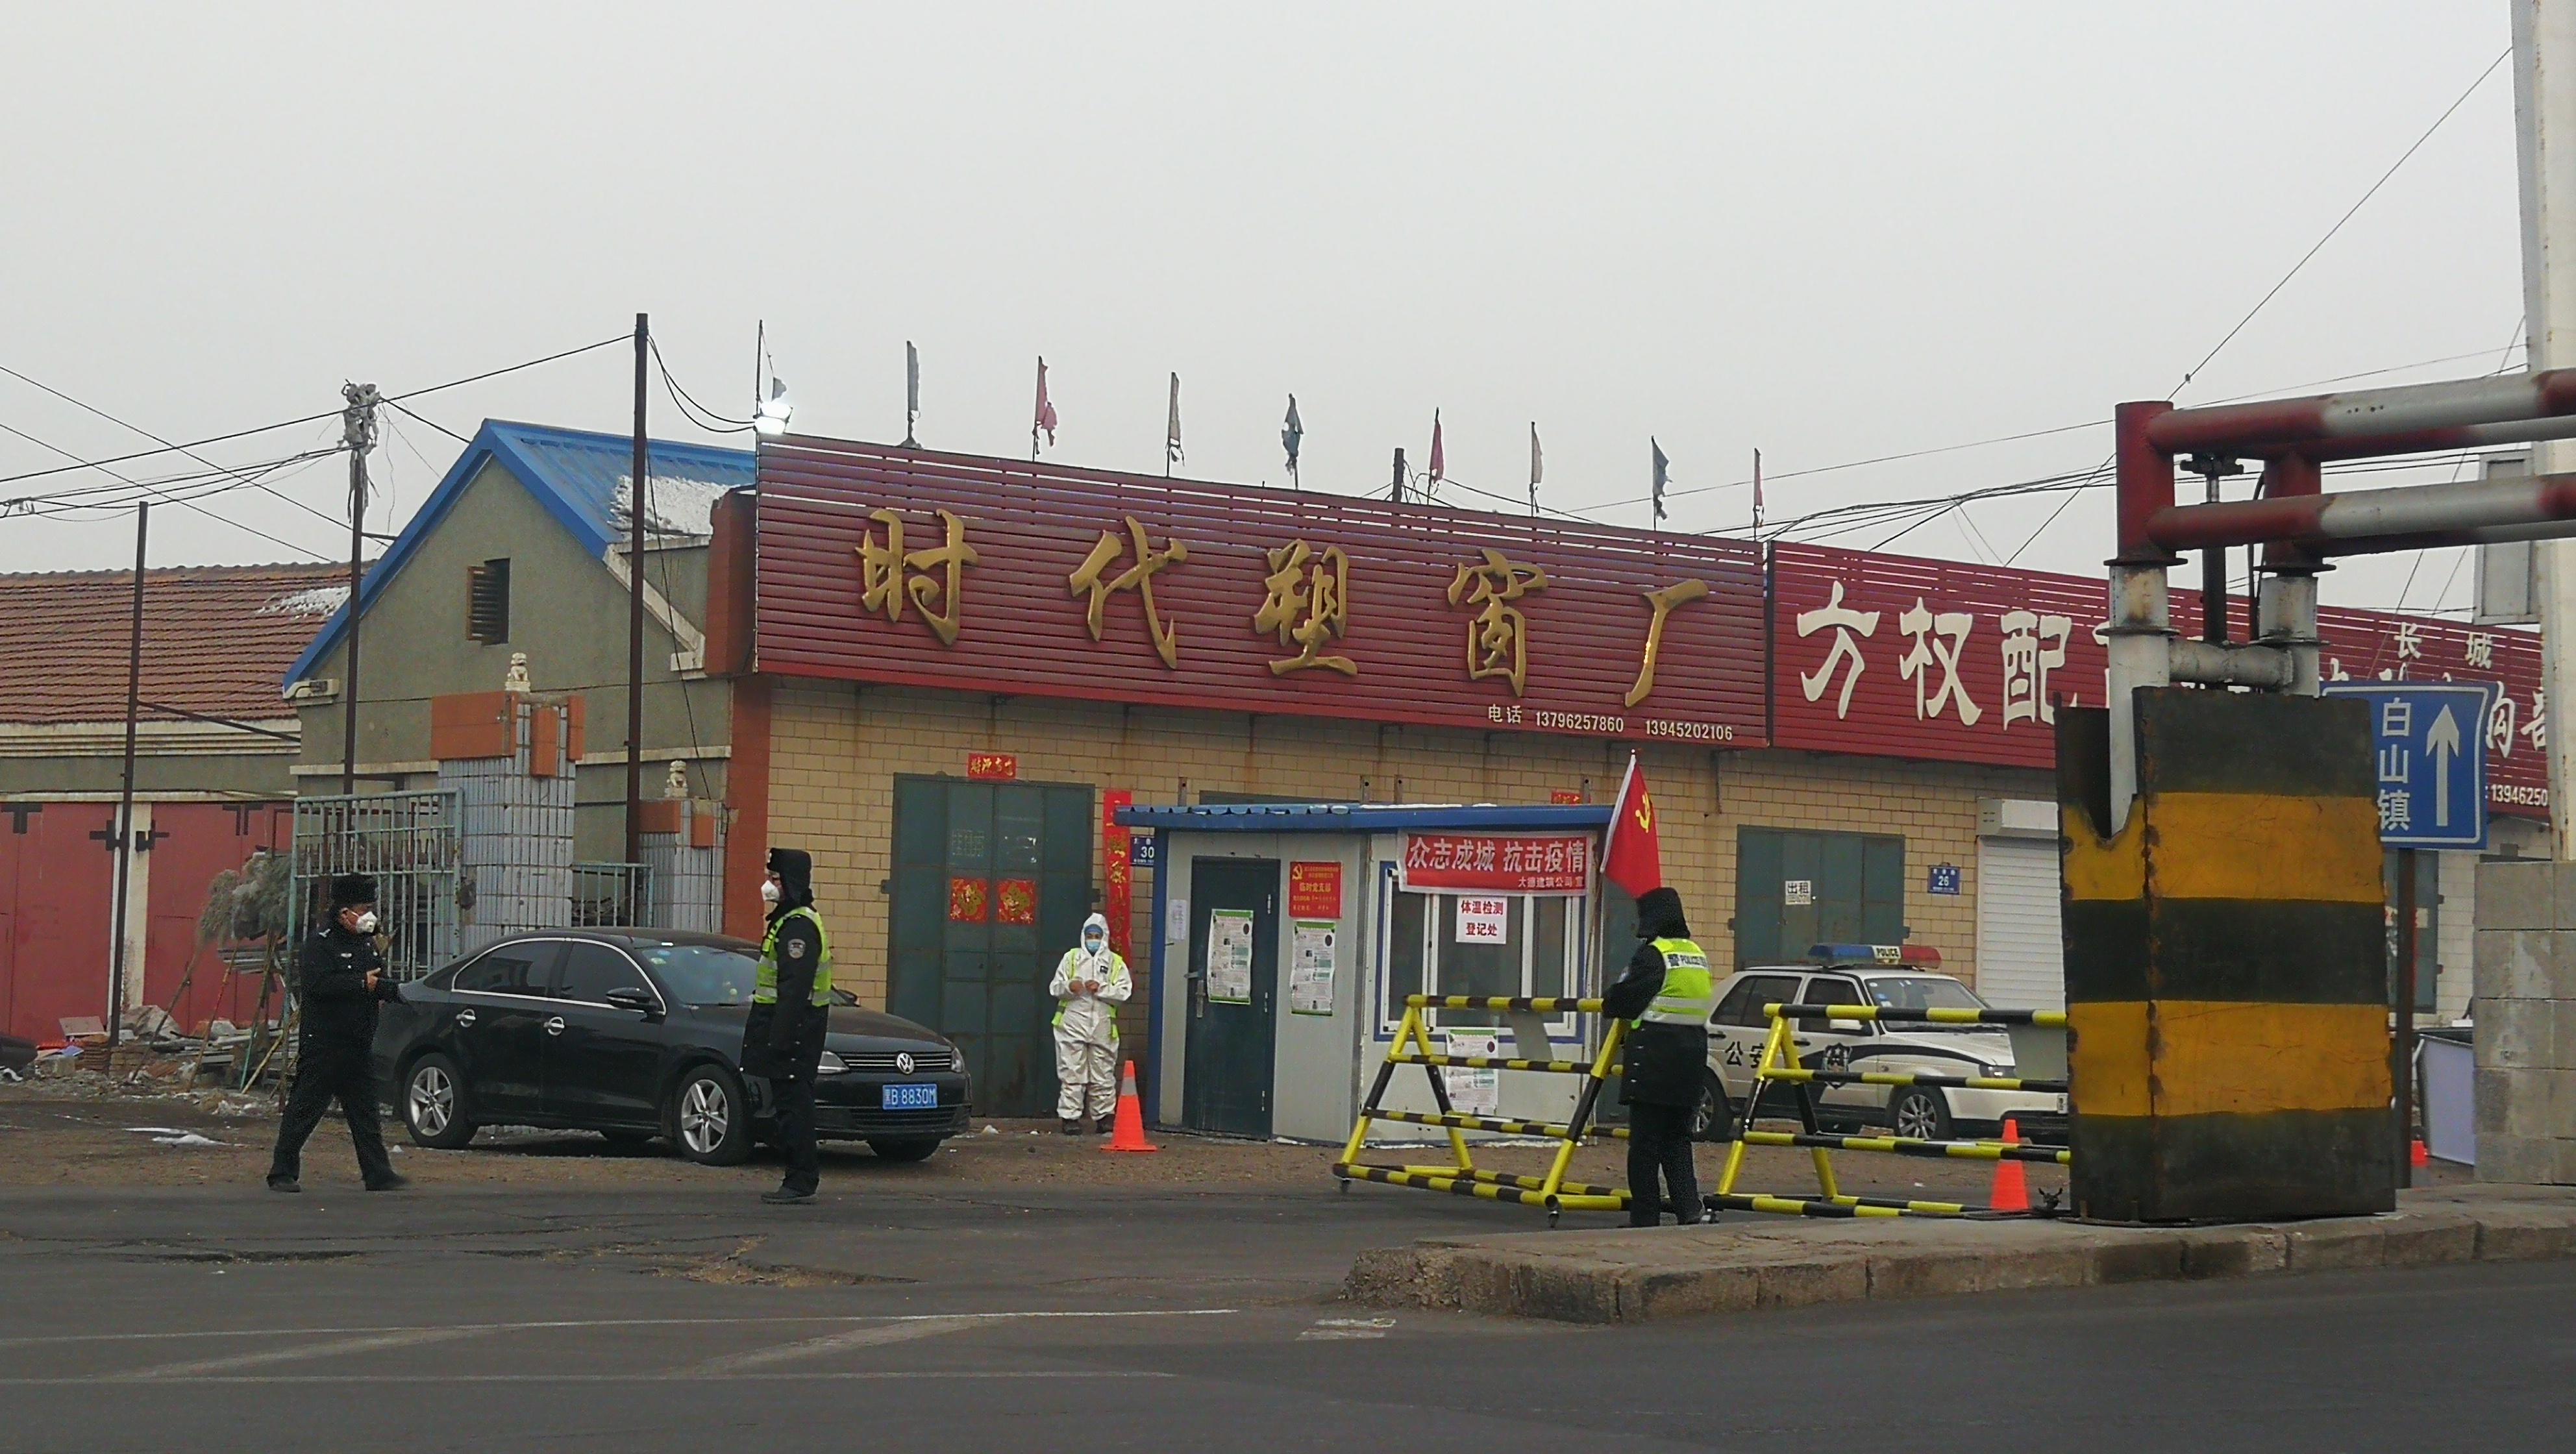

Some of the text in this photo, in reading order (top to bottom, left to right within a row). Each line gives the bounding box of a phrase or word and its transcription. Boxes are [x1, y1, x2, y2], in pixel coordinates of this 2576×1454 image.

[855, 509, 1710, 709] 时代塑窗厂
[1797, 580, 2110, 730] 方权配
[1488, 704, 1733, 741] 电话 13796257860 13945202106
[2377, 697, 2412, 832] 白山镇
[1141, 846, 1154, 858] 30
[1407, 837, 1585, 873] 众志成城 抗击疫情
[1787, 882, 1809, 894] 出租
[1938, 876, 1949, 886] 26
[1461, 900, 1504, 915] 体温检测
[1466, 922, 1497, 936] 登记处
[1876, 948, 1900, 957] POLICE
